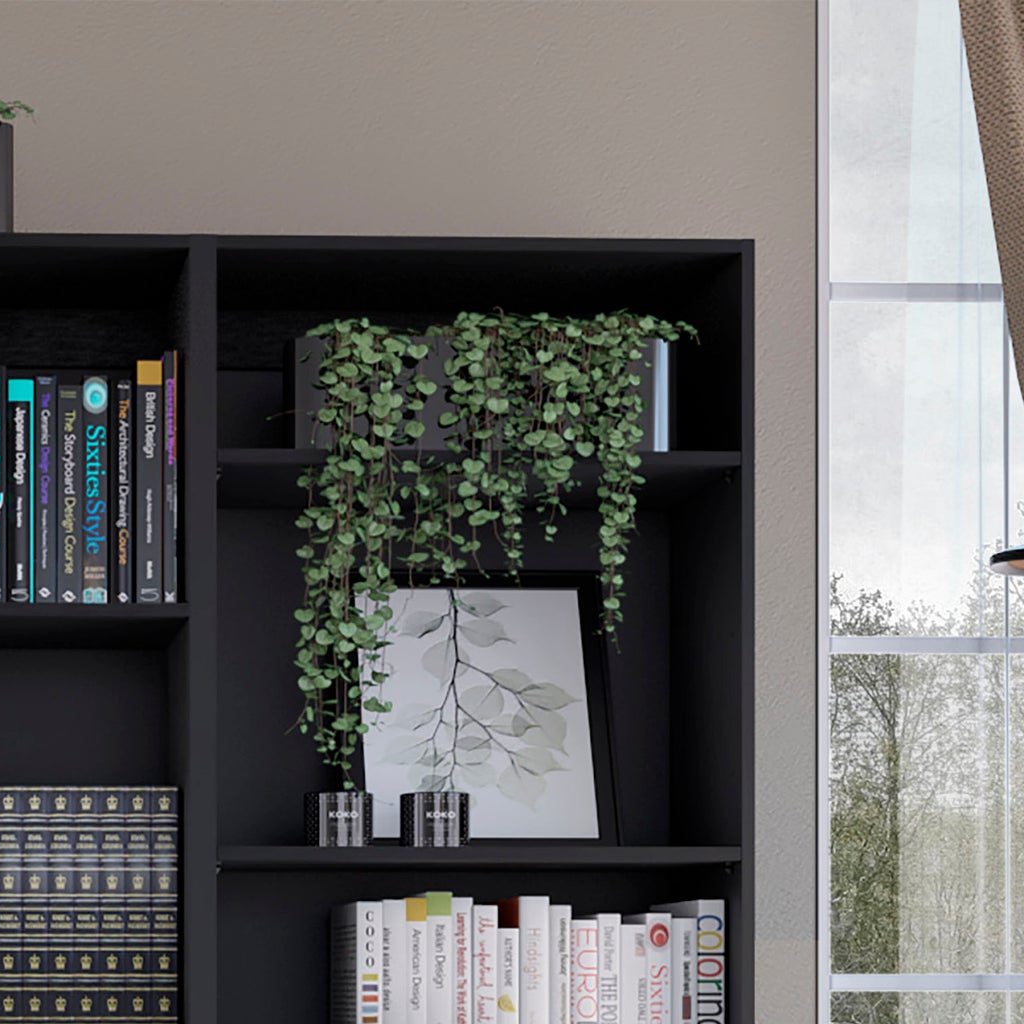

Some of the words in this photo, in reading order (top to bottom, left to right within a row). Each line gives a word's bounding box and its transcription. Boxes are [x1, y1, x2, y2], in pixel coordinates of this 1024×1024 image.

[42, 393, 51, 408] The
[119, 399, 129, 419] The
[145, 392, 156, 422] British
[13, 407, 26, 451] Japanese
[41, 409, 51, 445] Ceramics
[64, 410, 76, 432] The
[119, 420, 129, 484] Architectural
[143, 424, 156, 459] Design
[13, 453, 26, 485] Design
[39, 446, 51, 474] Design
[62, 433, 76, 494] Storyboard
[41, 475, 51, 504] Course
[62, 496, 76, 533] Design
[115, 485, 129, 528] Drawing
[64, 535, 76, 574] Course
[119, 528, 129, 566] Course
[435, 924, 445, 953] Italian
[604, 926, 615, 947] David
[412, 928, 422, 979] American
[604, 948, 615, 971] Porter
[433, 954, 445, 989] Design
[412, 979, 422, 1010] Design
[601, 976, 618, 1002] THE
